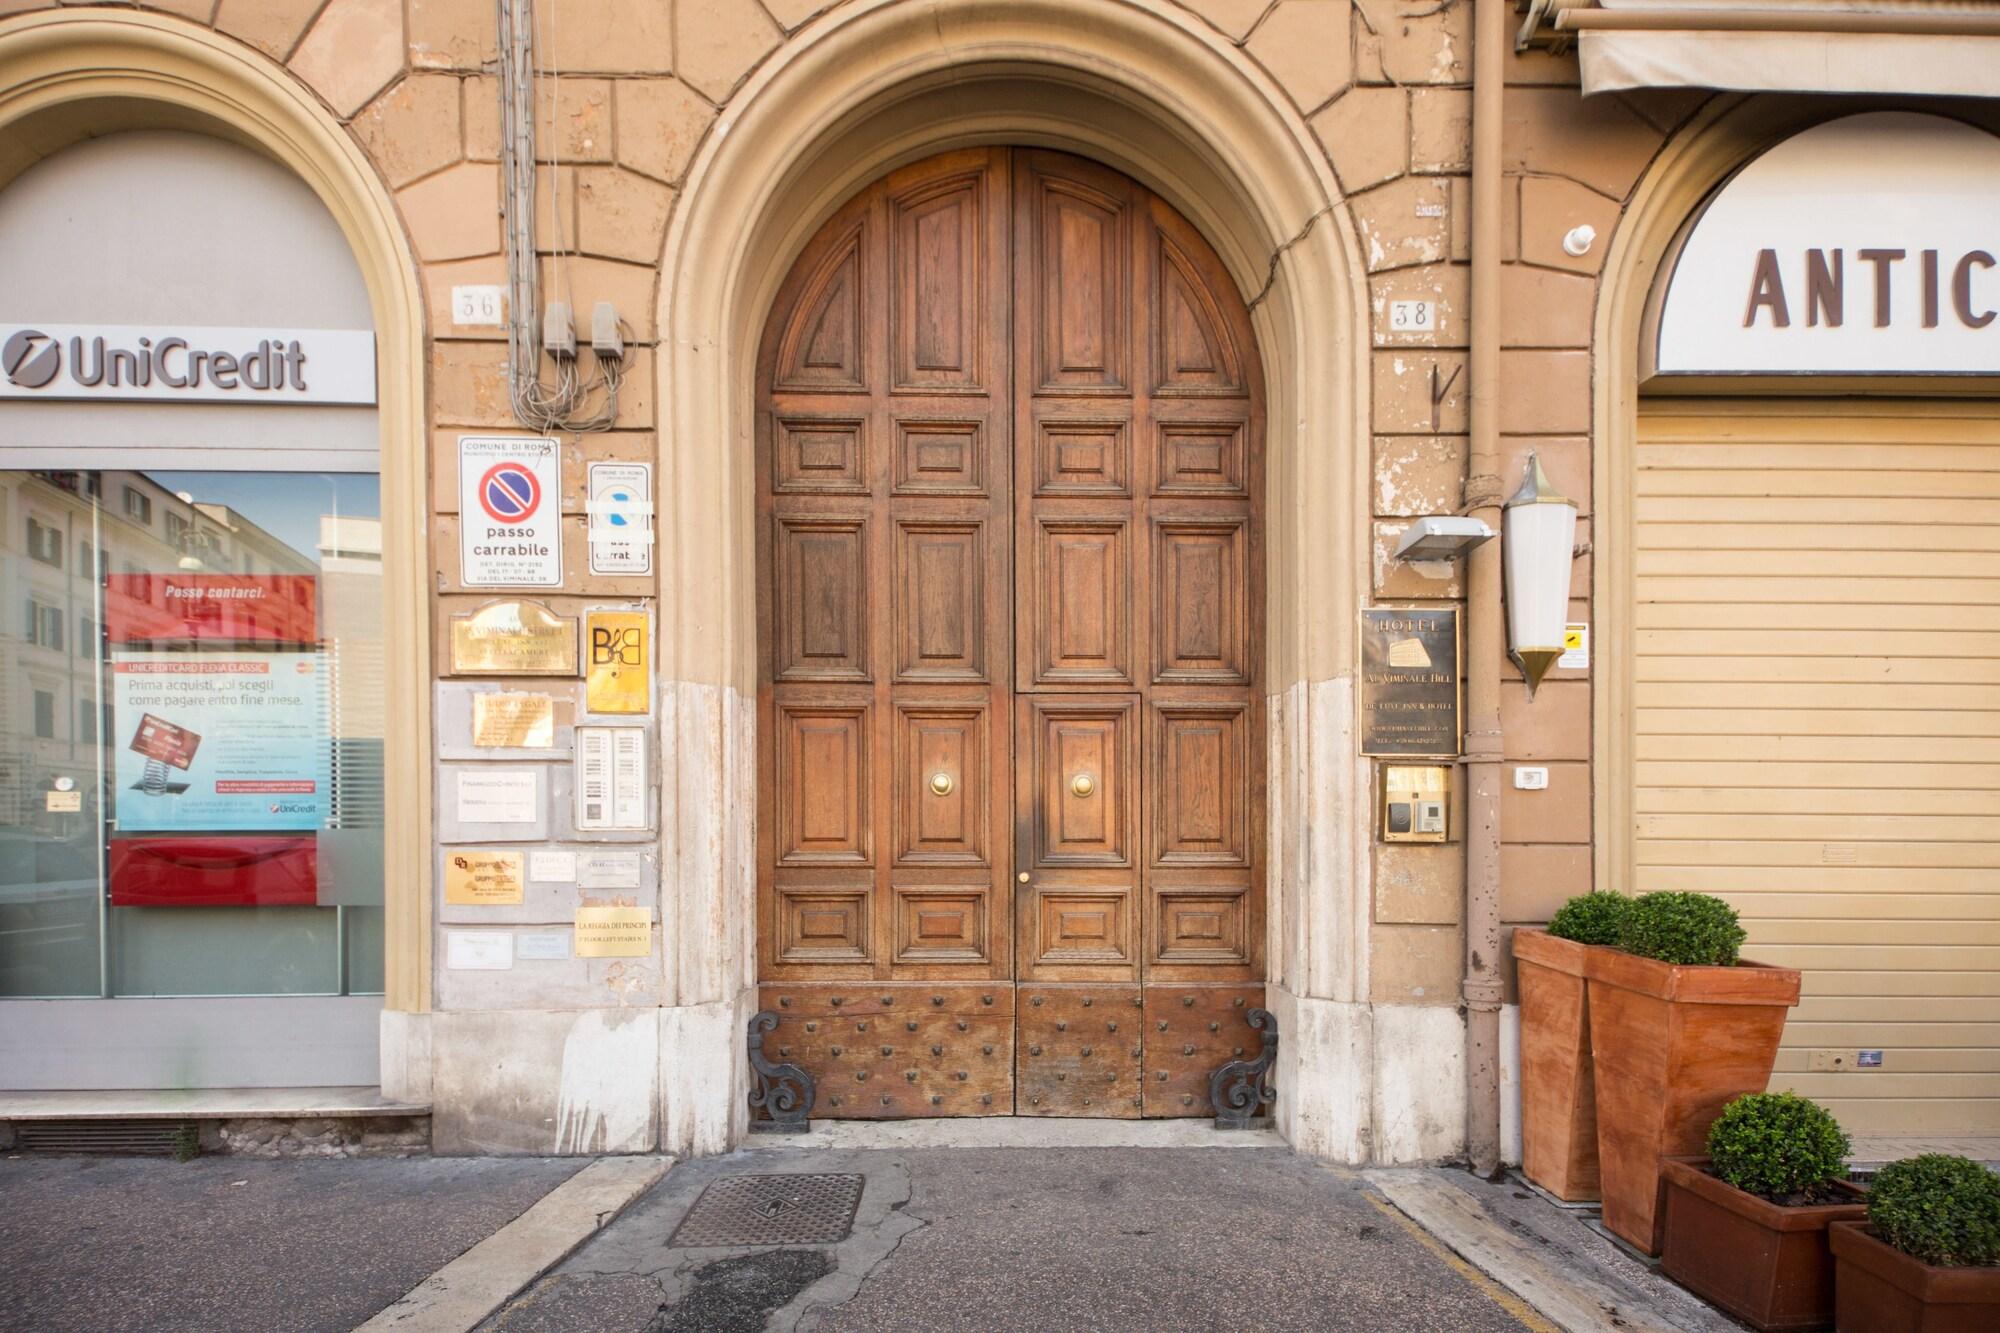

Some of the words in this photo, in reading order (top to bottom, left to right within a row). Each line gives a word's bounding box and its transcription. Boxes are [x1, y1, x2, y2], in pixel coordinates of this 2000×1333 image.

[1742, 248, 1998, 328] ANTIC
[463, 295, 493, 317] 36
[1395, 302, 1426, 325] 38
[69, 336, 307, 391] UniCredit
[511, 443, 521, 451] DI
[487, 528, 535, 539] passo
[473, 543, 549, 556] carrabile
[166, 585, 204, 599] Posso
[207, 585, 267, 600] contarci.
[1379, 619, 1440, 632] HOTEL
[228, 663, 264, 673] CLASSIC
[1383, 672, 1427, 684] VIMINALE
[1431, 672, 1453, 684] HILL
[129, 680, 163, 691] Prima
[166, 680, 215, 693] acquisti,
[239, 680, 273, 693] scegli
[129, 696, 161, 706] come
[165, 697, 205, 708] pagare
[208, 696, 238, 706] entro
[241, 695, 265, 706] fine
[267, 696, 303, 706] mese.
[280, 804, 316, 813] UniCredit
